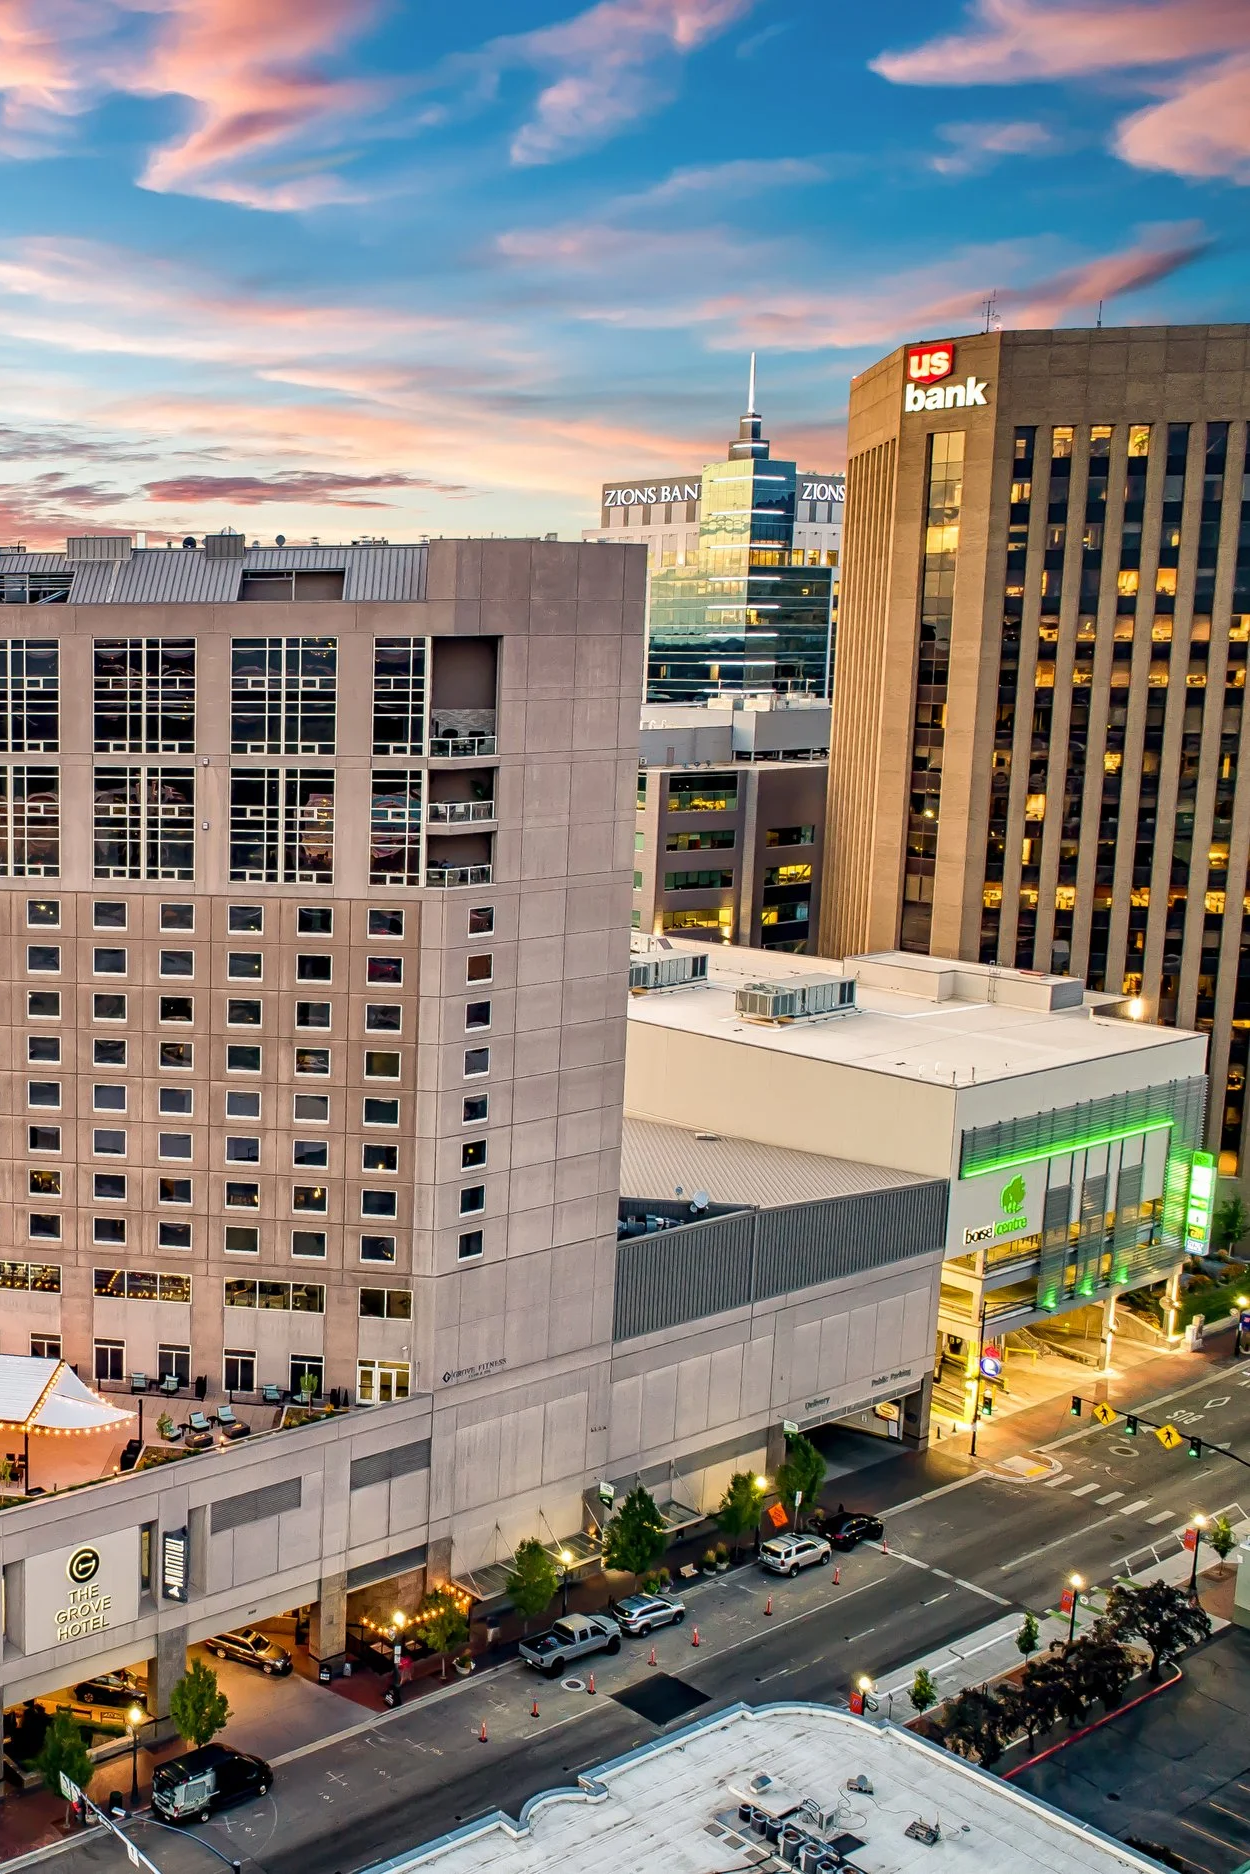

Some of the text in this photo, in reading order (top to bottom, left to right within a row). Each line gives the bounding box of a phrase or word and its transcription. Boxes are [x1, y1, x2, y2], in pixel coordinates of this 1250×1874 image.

[910, 351, 950, 378] us
[905, 376, 989, 412] bank
[604, 482, 702, 506] ZIONS BAN
[802, 482, 845, 502] ZIONS
[995, 1216, 1027, 1235] centre
[1165, 1409, 1205, 1425] BUS
[67, 1583, 100, 1604] THE
[54, 1595, 112, 1624] GROVE
[57, 1614, 110, 1641] HOTEL
